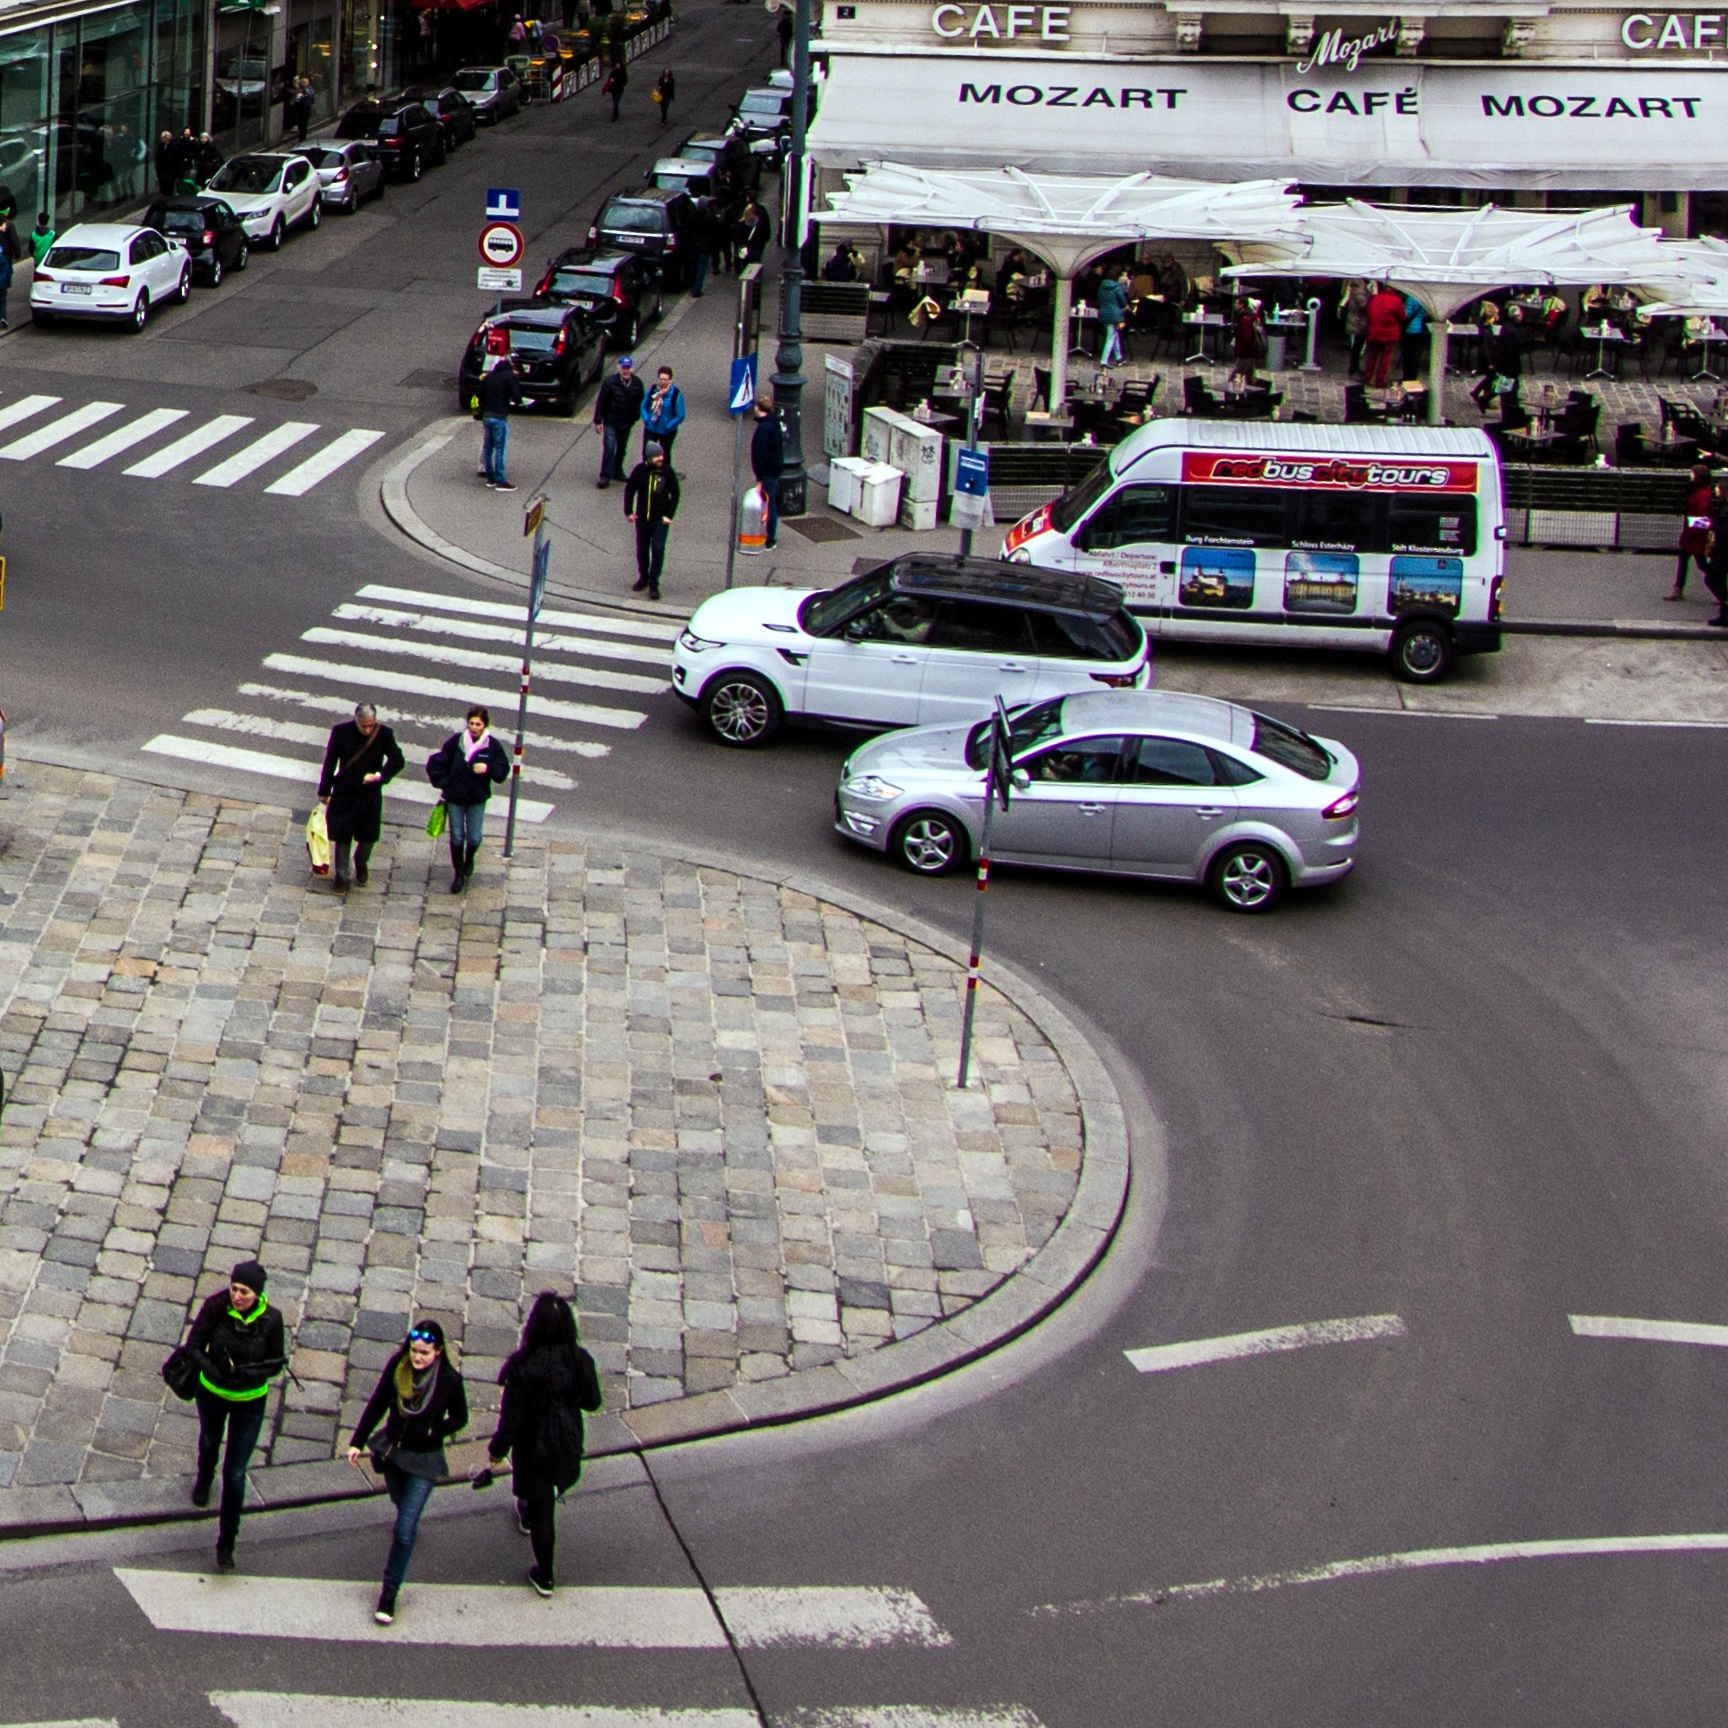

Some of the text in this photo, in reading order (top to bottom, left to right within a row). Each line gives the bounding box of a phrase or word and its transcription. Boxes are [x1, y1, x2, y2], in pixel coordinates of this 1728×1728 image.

[932, 4, 1072, 41] CAFE
[1621, 14, 1728, 50] CAF
[1296, 16, 1400, 74] Mozart
[959, 83, 1187, 109] MOZART
[1287, 87, 1419, 115] CAFÉ
[1480, 95, 1702, 119] MOZART
